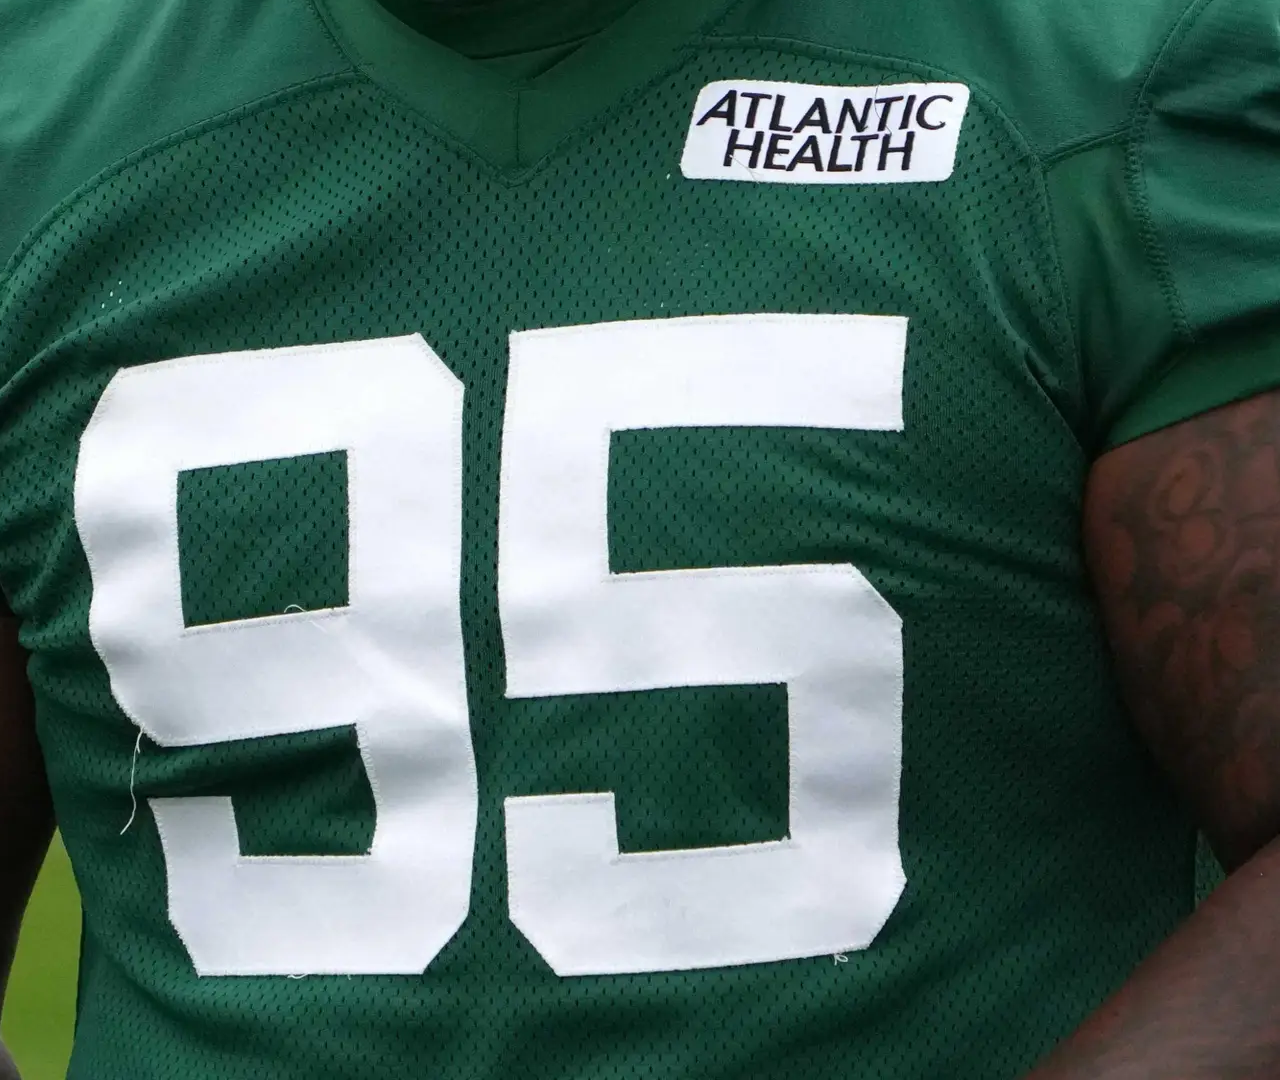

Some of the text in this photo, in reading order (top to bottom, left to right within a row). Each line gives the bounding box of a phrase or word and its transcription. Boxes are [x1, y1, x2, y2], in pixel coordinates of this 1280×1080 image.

[696, 89, 954, 135] ATLANTIC
[722, 129, 916, 172] HEALTH
[74, 313, 908, 977] 95
